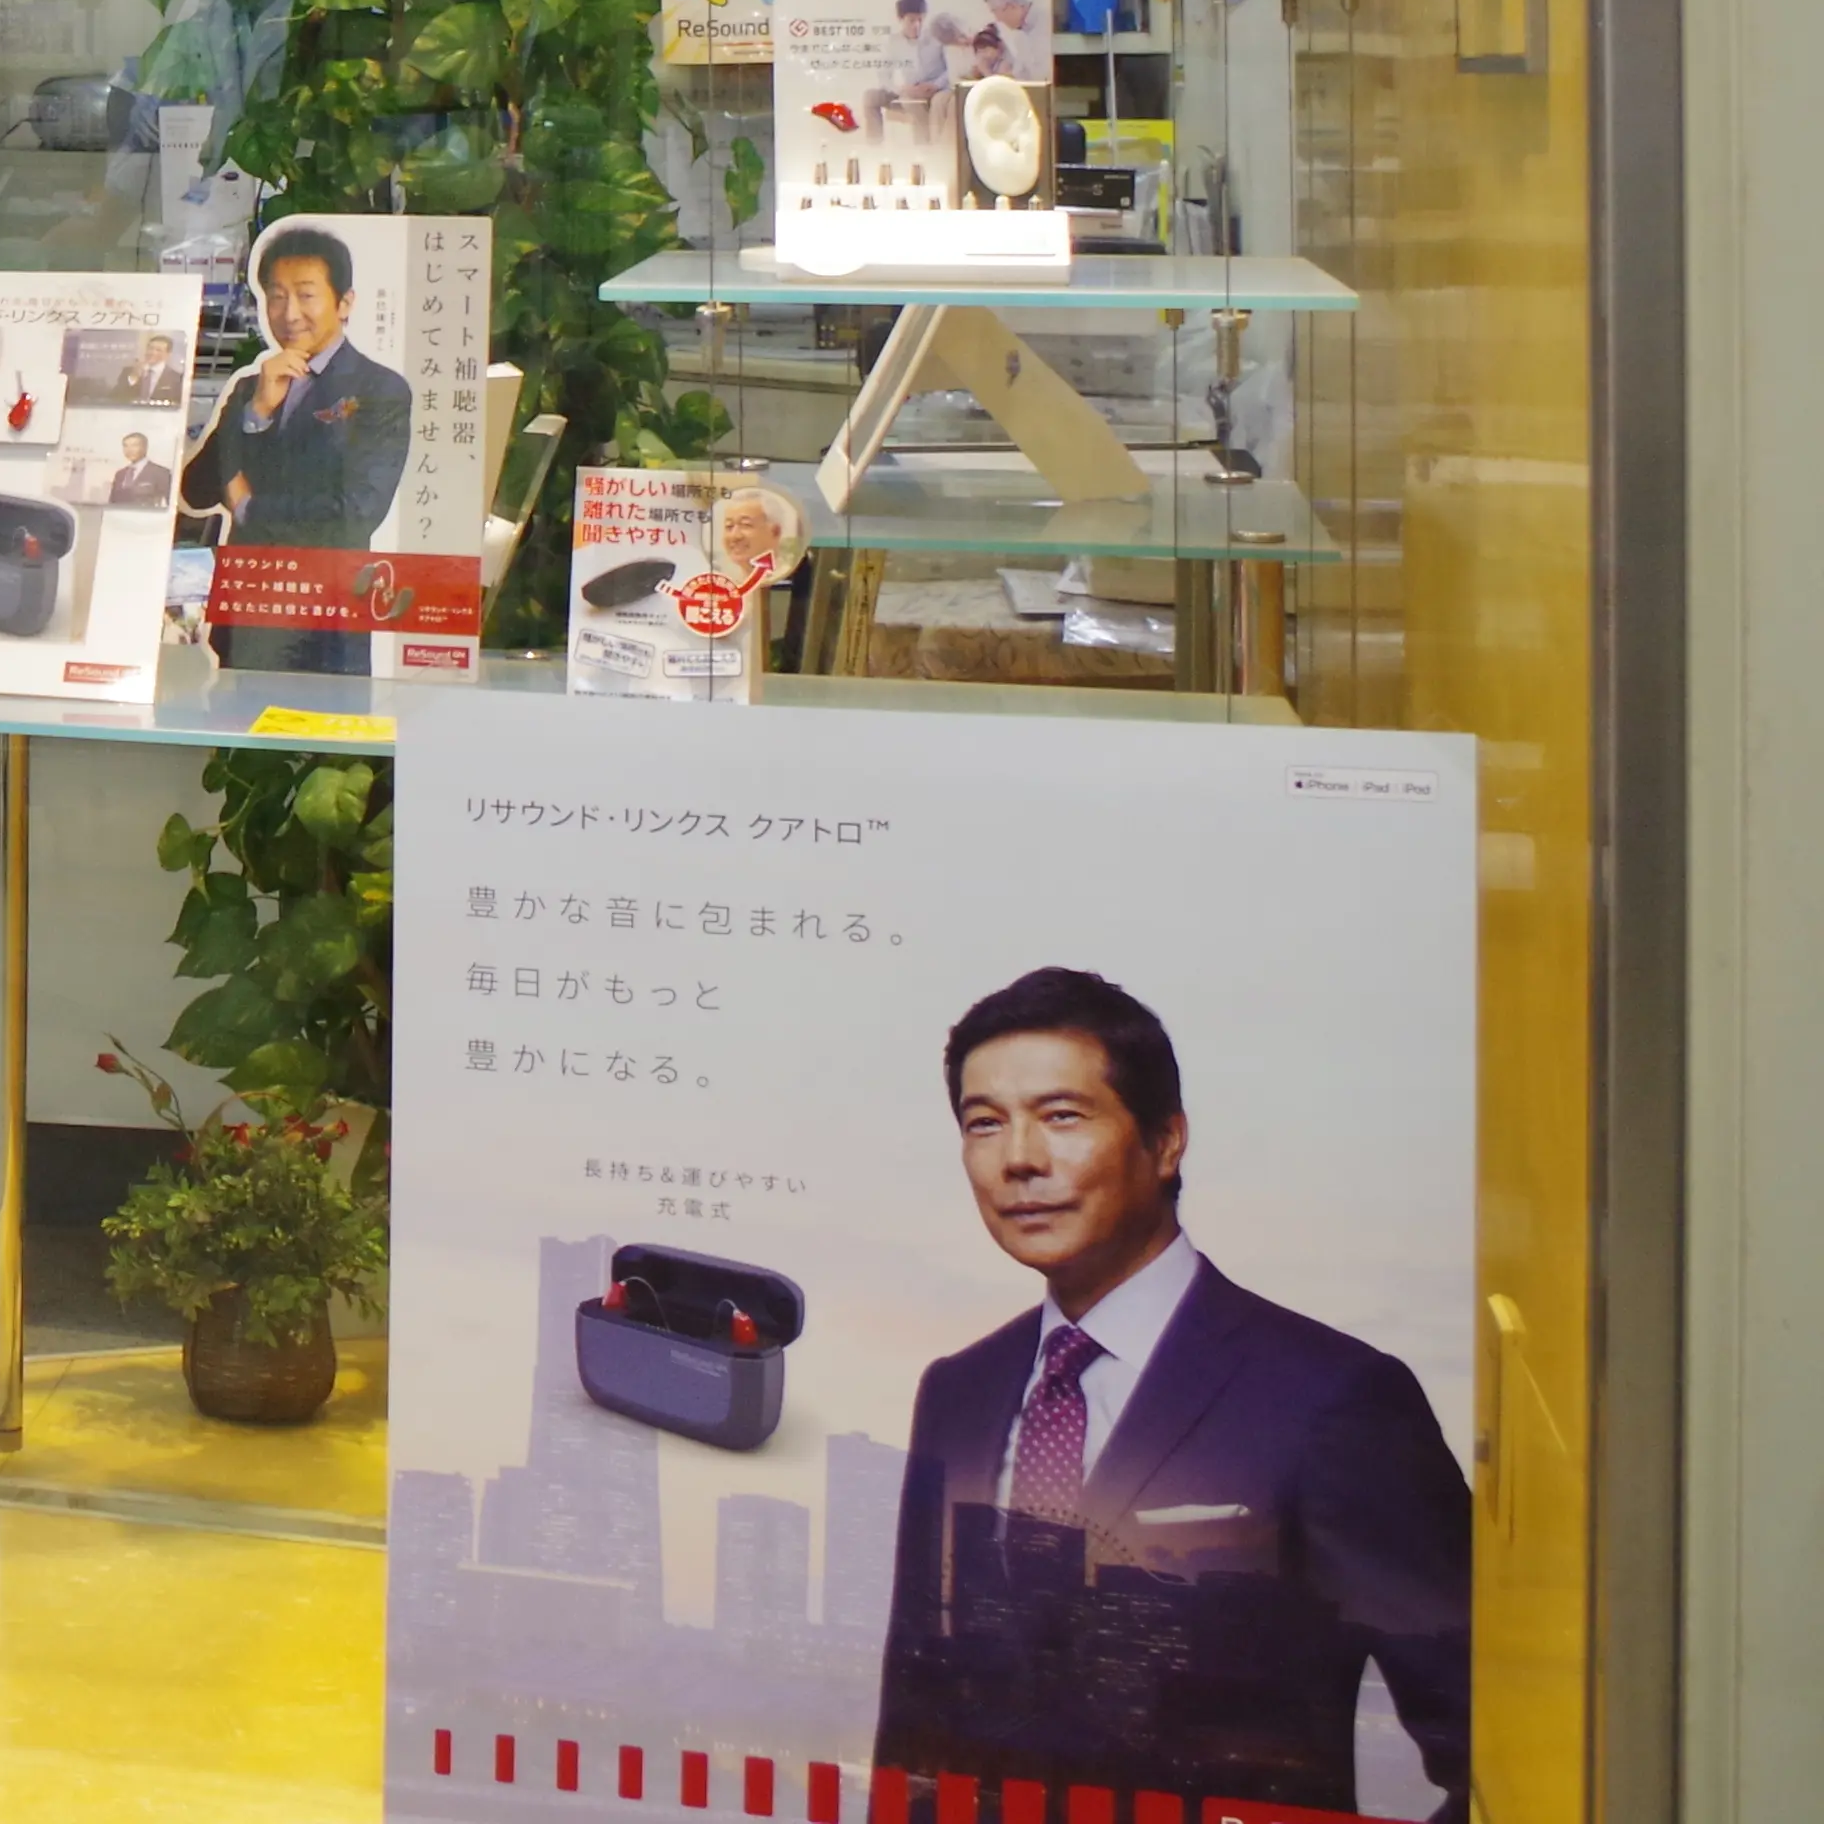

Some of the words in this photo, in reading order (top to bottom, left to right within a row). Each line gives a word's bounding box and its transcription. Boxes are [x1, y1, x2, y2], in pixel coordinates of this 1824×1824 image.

[677, 19, 770, 38] ReSound
[813, 26, 842, 36] BEST
[90, 310, 160, 326] クアトロ
[416, 231, 445, 539] はじめてみませんか？
[584, 477, 733, 500] 騒がしい場所でも
[583, 500, 712, 523] 離れた場所でも
[582, 523, 686, 546] 聞きやすい
[221, 557, 298, 571] リサウンドの
[220, 580, 324, 594] スマート補聴器で
[466, 797, 730, 838] リサウンド・リンクス
[466, 885, 903, 947] 豊かな音に包まれる。
[466, 962, 722, 1012] 毎日がもっと
[464, 1038, 710, 1089] 豊かになる。
[657, 1196, 731, 1221] 充電式
